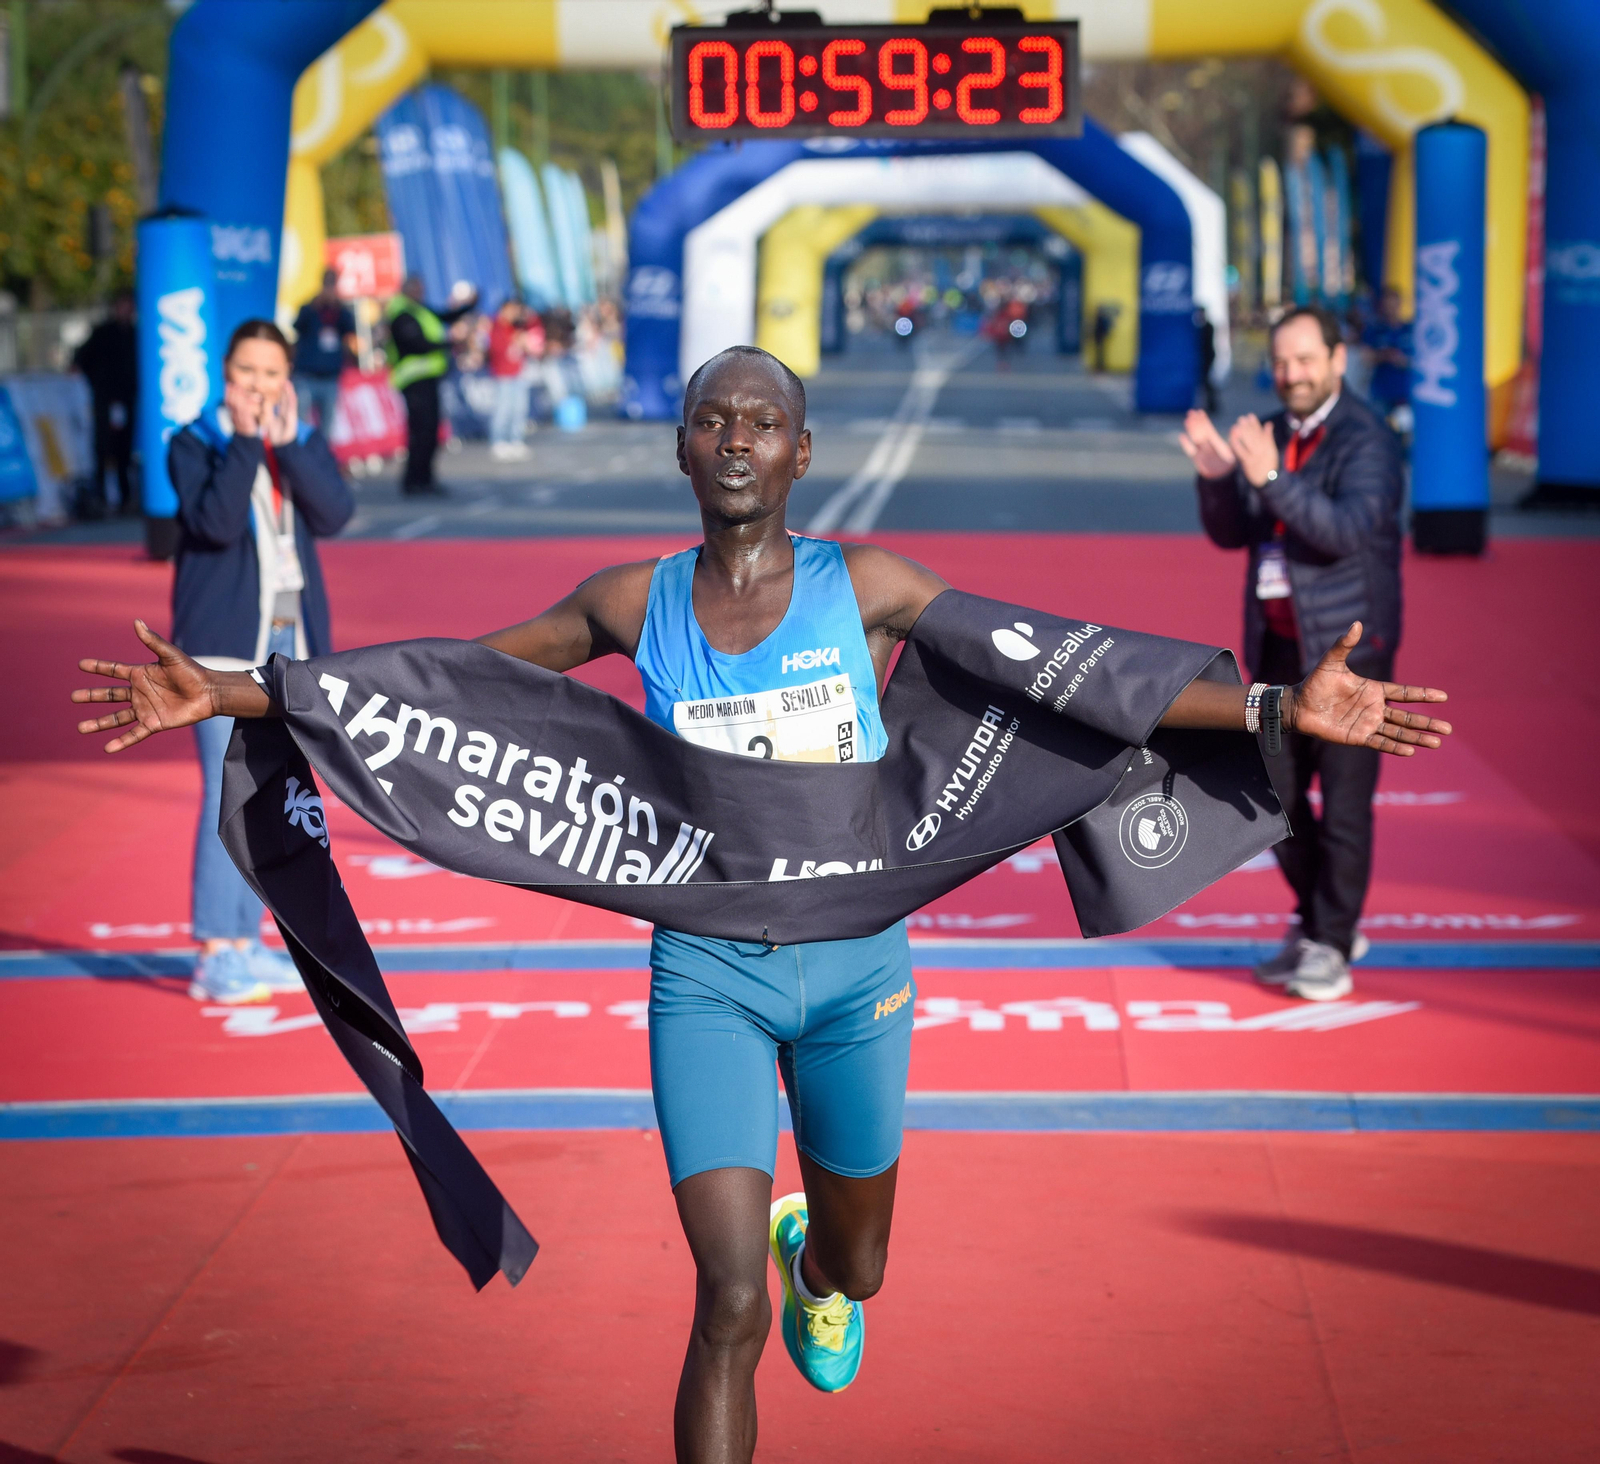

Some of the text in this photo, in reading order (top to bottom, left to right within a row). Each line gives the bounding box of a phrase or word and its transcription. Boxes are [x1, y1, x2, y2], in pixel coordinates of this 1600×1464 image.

[688, 36, 1063, 128] 00:59:23
[1412, 241, 1460, 406] HOKA
[781, 647, 841, 674] HOKA
[1079, 636, 1115, 674] Partner
[687, 697, 756, 720] MEDIO MARATÓN
[780, 684, 832, 713] SEVILLA
[399, 703, 659, 846] maratón
[935, 704, 1005, 812] HYUNDAI
[955, 716, 1021, 821] Hyundauto Motor
[447, 784, 652, 884] sevilla
[1156, 815, 1168, 837] WORLD
[1159, 808, 1175, 838] ATHLETICS
[1176, 808, 1185, 826] ROAD
[874, 981, 912, 1020] HOKA
